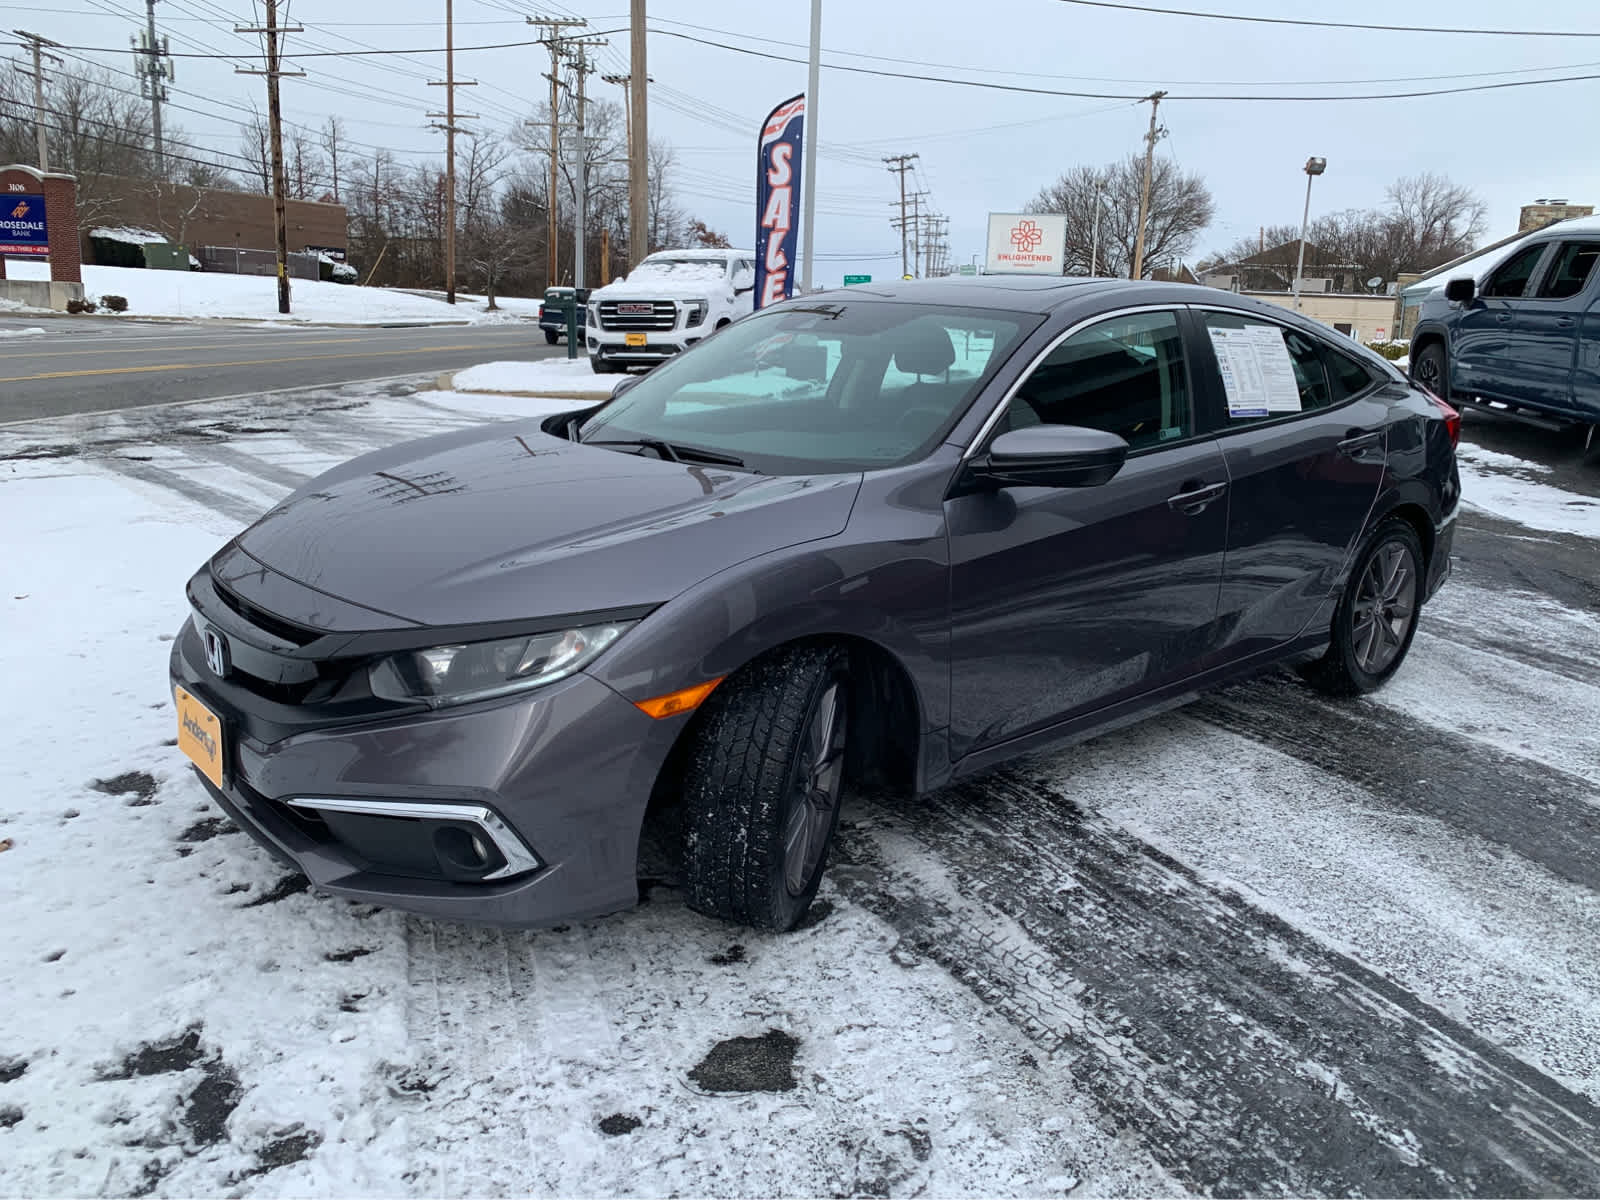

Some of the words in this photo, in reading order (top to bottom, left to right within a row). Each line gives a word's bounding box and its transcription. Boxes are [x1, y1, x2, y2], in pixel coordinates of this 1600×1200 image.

[8, 183, 25, 192] 3106
[0, 220, 44, 230] ROSEDALE
[761, 142, 793, 308] SALE
[998, 254, 1053, 262] ENLIGHTENED
